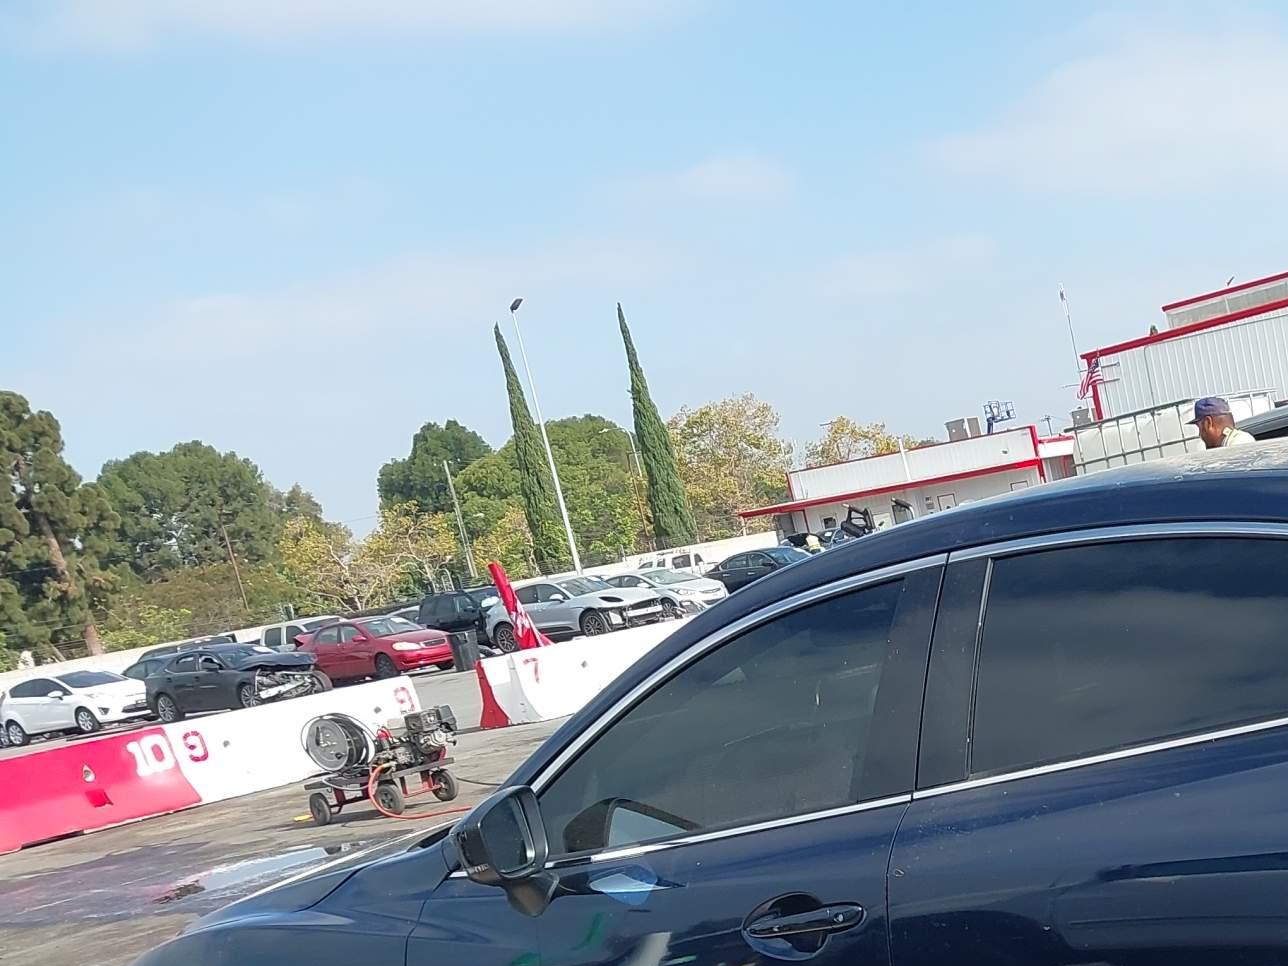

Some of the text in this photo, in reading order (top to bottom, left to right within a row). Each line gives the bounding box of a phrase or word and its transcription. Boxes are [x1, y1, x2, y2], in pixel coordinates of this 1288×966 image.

[523, 657, 540, 684] 7
[125, 733, 177, 777] 10
[182, 730, 209, 762] 9
